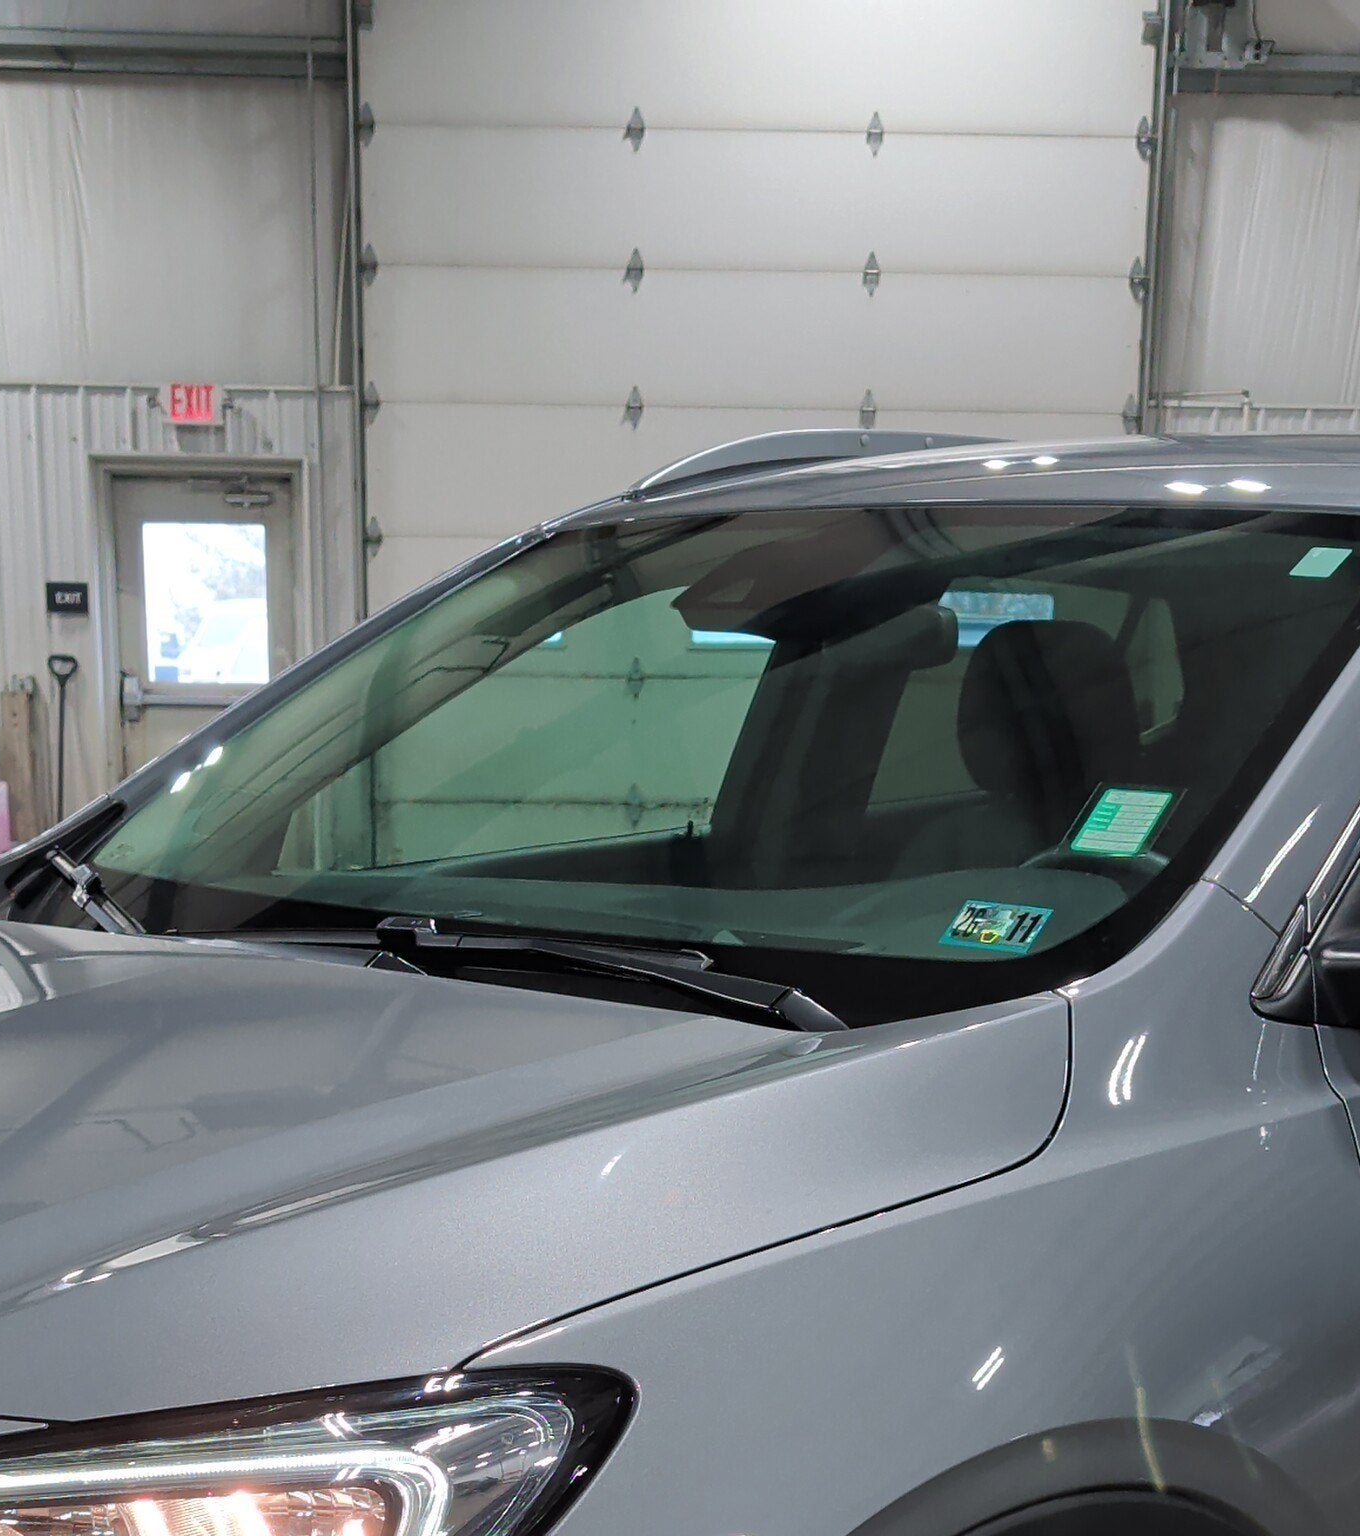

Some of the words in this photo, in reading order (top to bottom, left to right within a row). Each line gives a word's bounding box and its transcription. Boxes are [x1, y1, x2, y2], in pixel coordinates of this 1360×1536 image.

[171, 384, 214, 421] EXIT
[55, 591, 82, 605] EXIT
[950, 905, 987, 938] 26
[1005, 912, 1043, 943] 11
